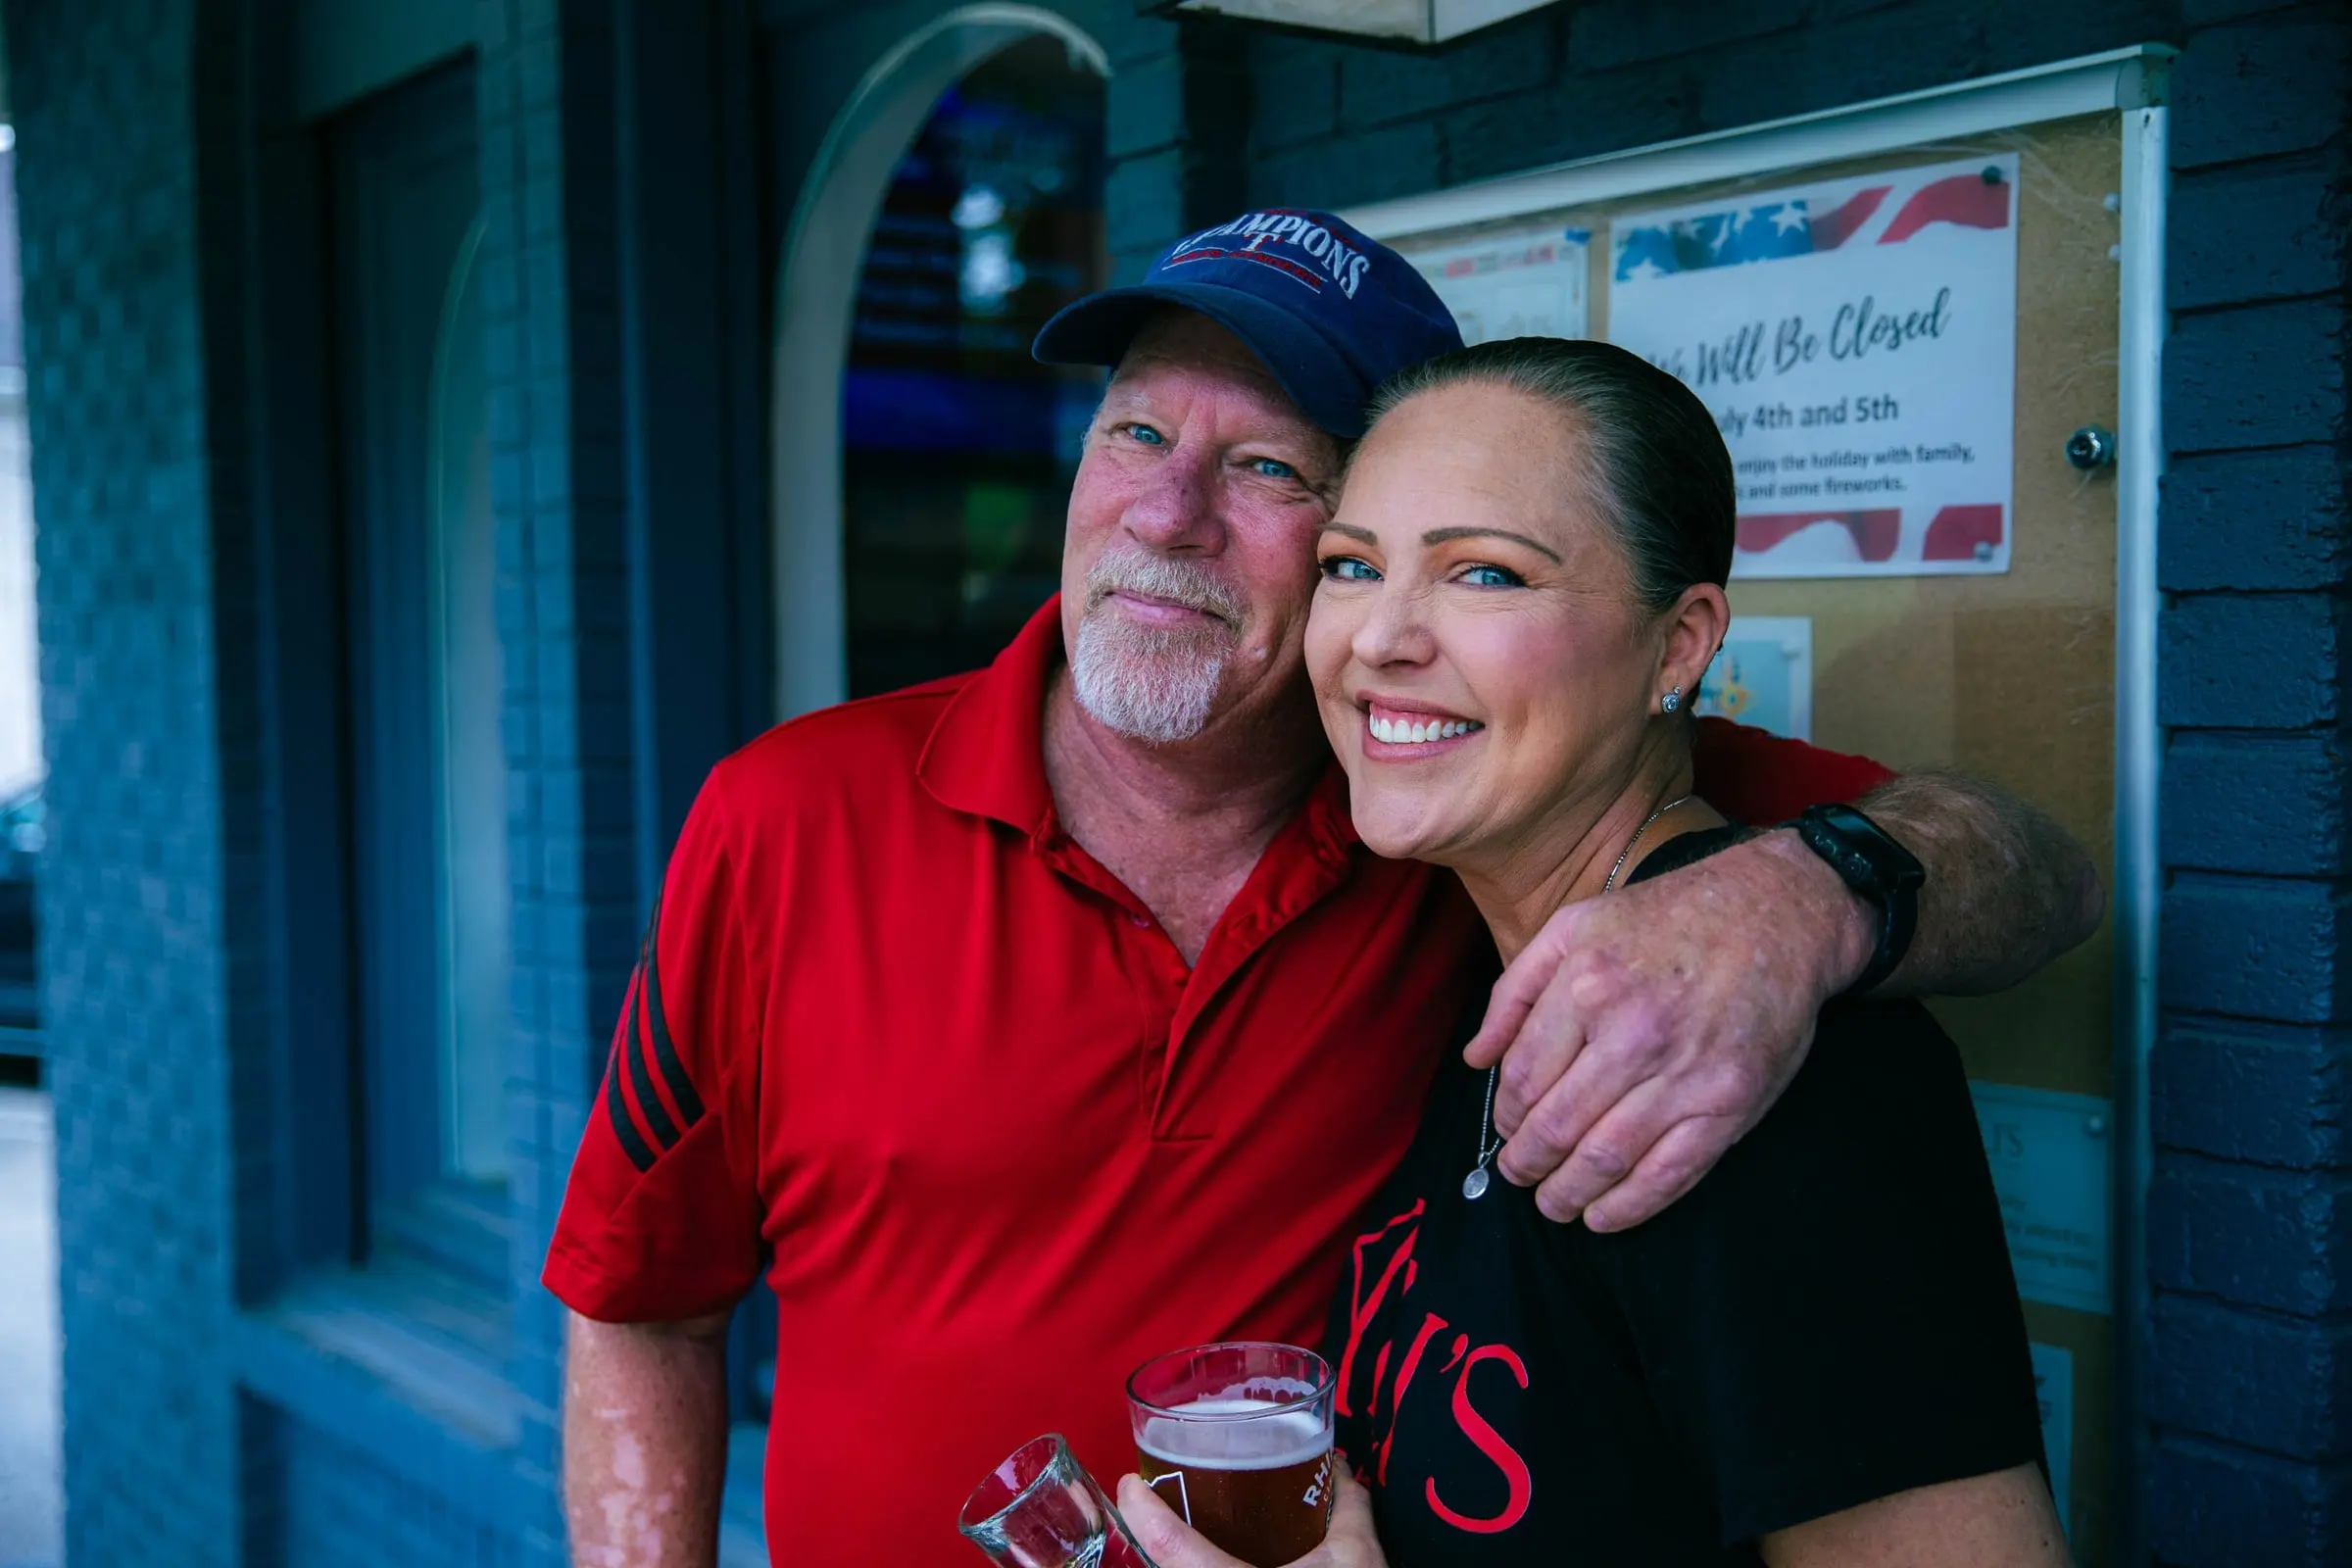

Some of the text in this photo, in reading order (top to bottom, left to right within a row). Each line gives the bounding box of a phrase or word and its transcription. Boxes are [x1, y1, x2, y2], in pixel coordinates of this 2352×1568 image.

[1695, 321, 1765, 389] Will
[1774, 315, 1821, 376] Be
[1830, 287, 1952, 364] Closed
[1720, 394, 1898, 437] uly 4th and 5th
[1781, 455, 1807, 470] the
[1811, 451, 1869, 472] holiday
[1874, 447, 1912, 466] with
[1916, 444, 1975, 466] family,
[1748, 483, 1776, 501] and
[1780, 483, 1820, 499] some
[1825, 475, 1907, 498] fireworks.
